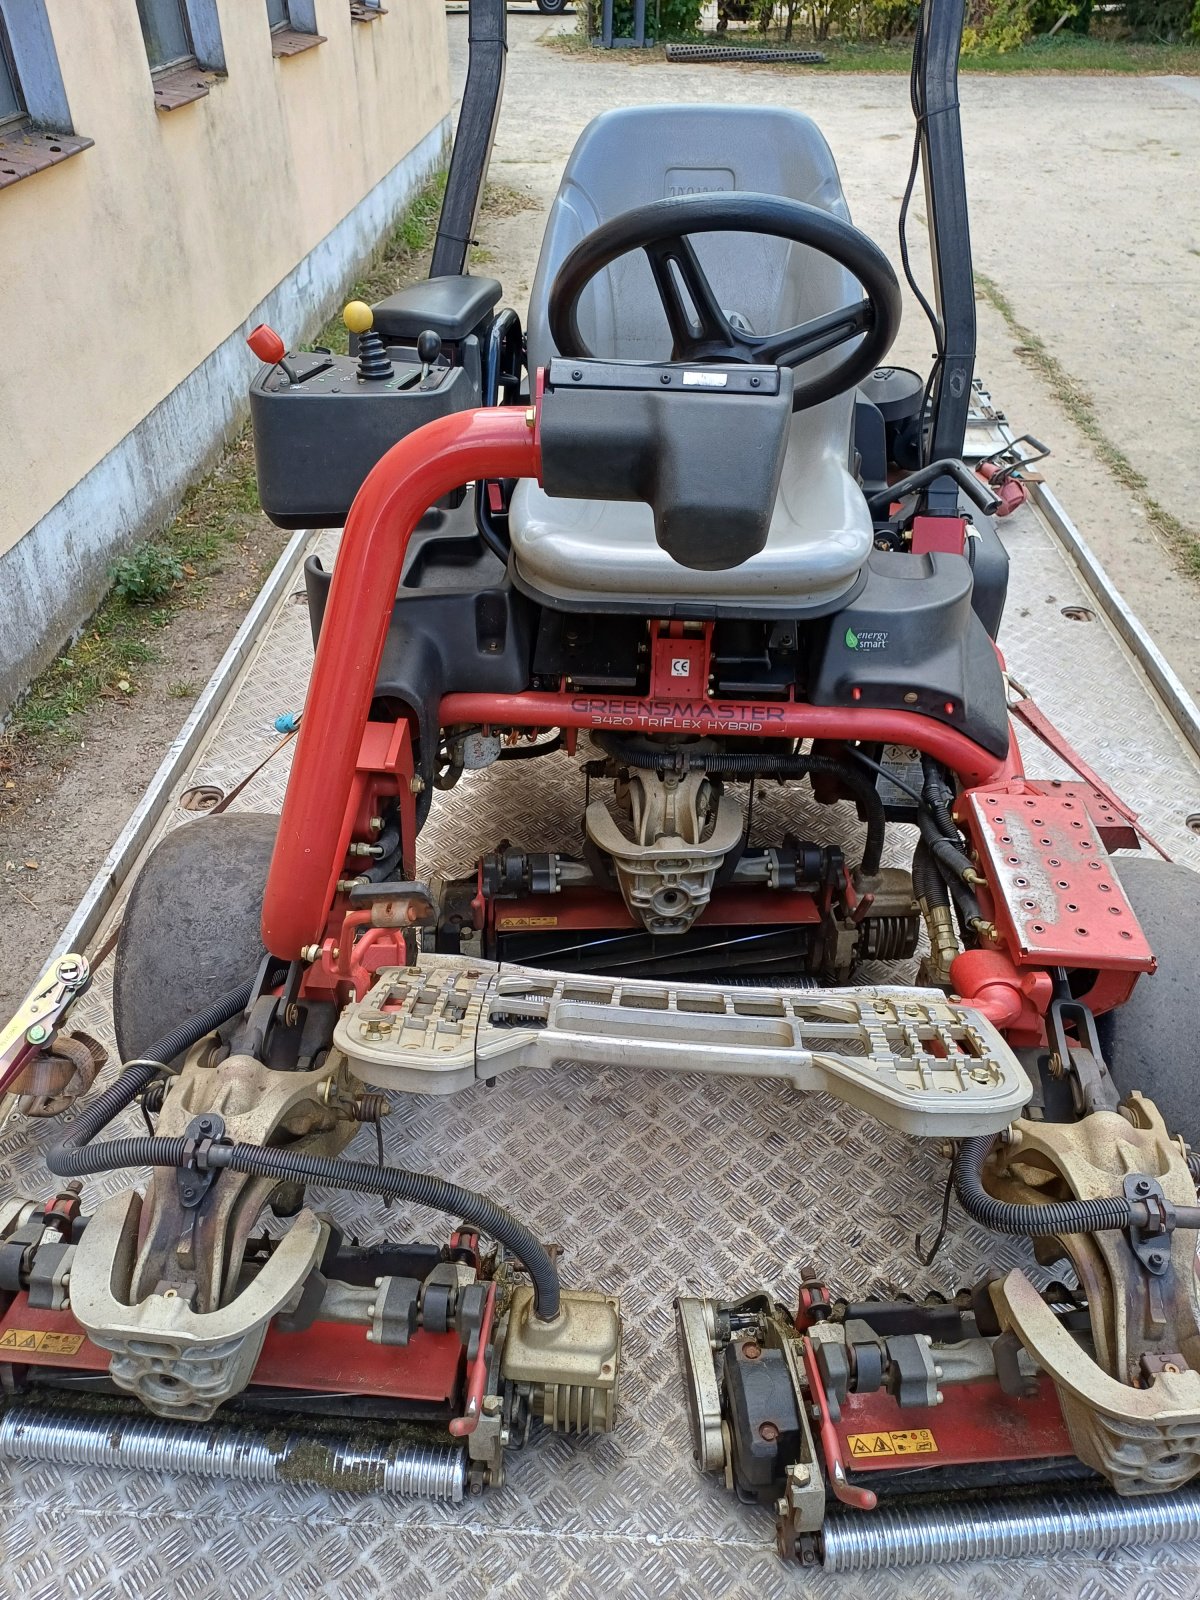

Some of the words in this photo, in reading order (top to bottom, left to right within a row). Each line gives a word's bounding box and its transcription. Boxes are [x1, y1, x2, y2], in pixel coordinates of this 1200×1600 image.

[857, 632, 889, 642] energy
[859, 639, 886, 649] smart
[673, 660, 689, 673] CE
[571, 698, 785, 721] GREENSMASTER
[591, 715, 634, 726] 3420
[707, 721, 763, 732] HYBRID
